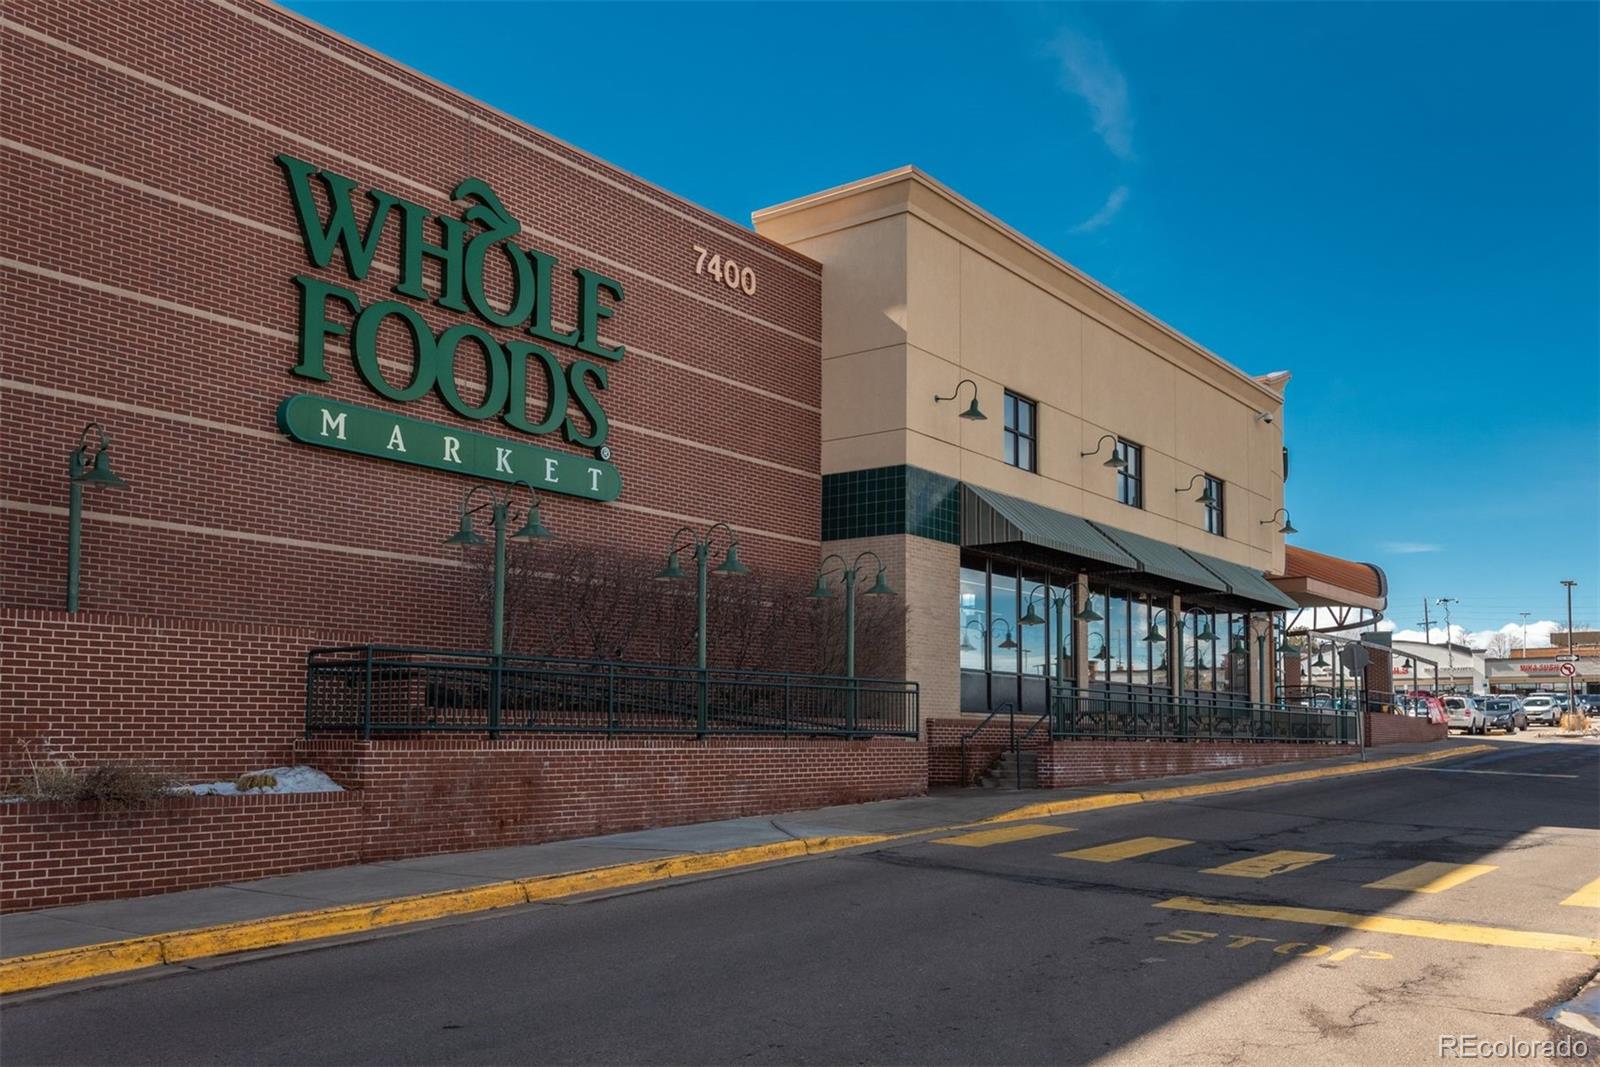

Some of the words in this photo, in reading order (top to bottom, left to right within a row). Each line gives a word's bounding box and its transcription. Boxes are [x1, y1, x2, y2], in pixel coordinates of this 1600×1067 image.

[275, 154, 625, 361] WHOLE
[693, 245, 757, 296] 7400
[288, 274, 610, 448] FOODS
[320, 408, 603, 493] MARKET
[1155, 929, 1393, 961] STOP
